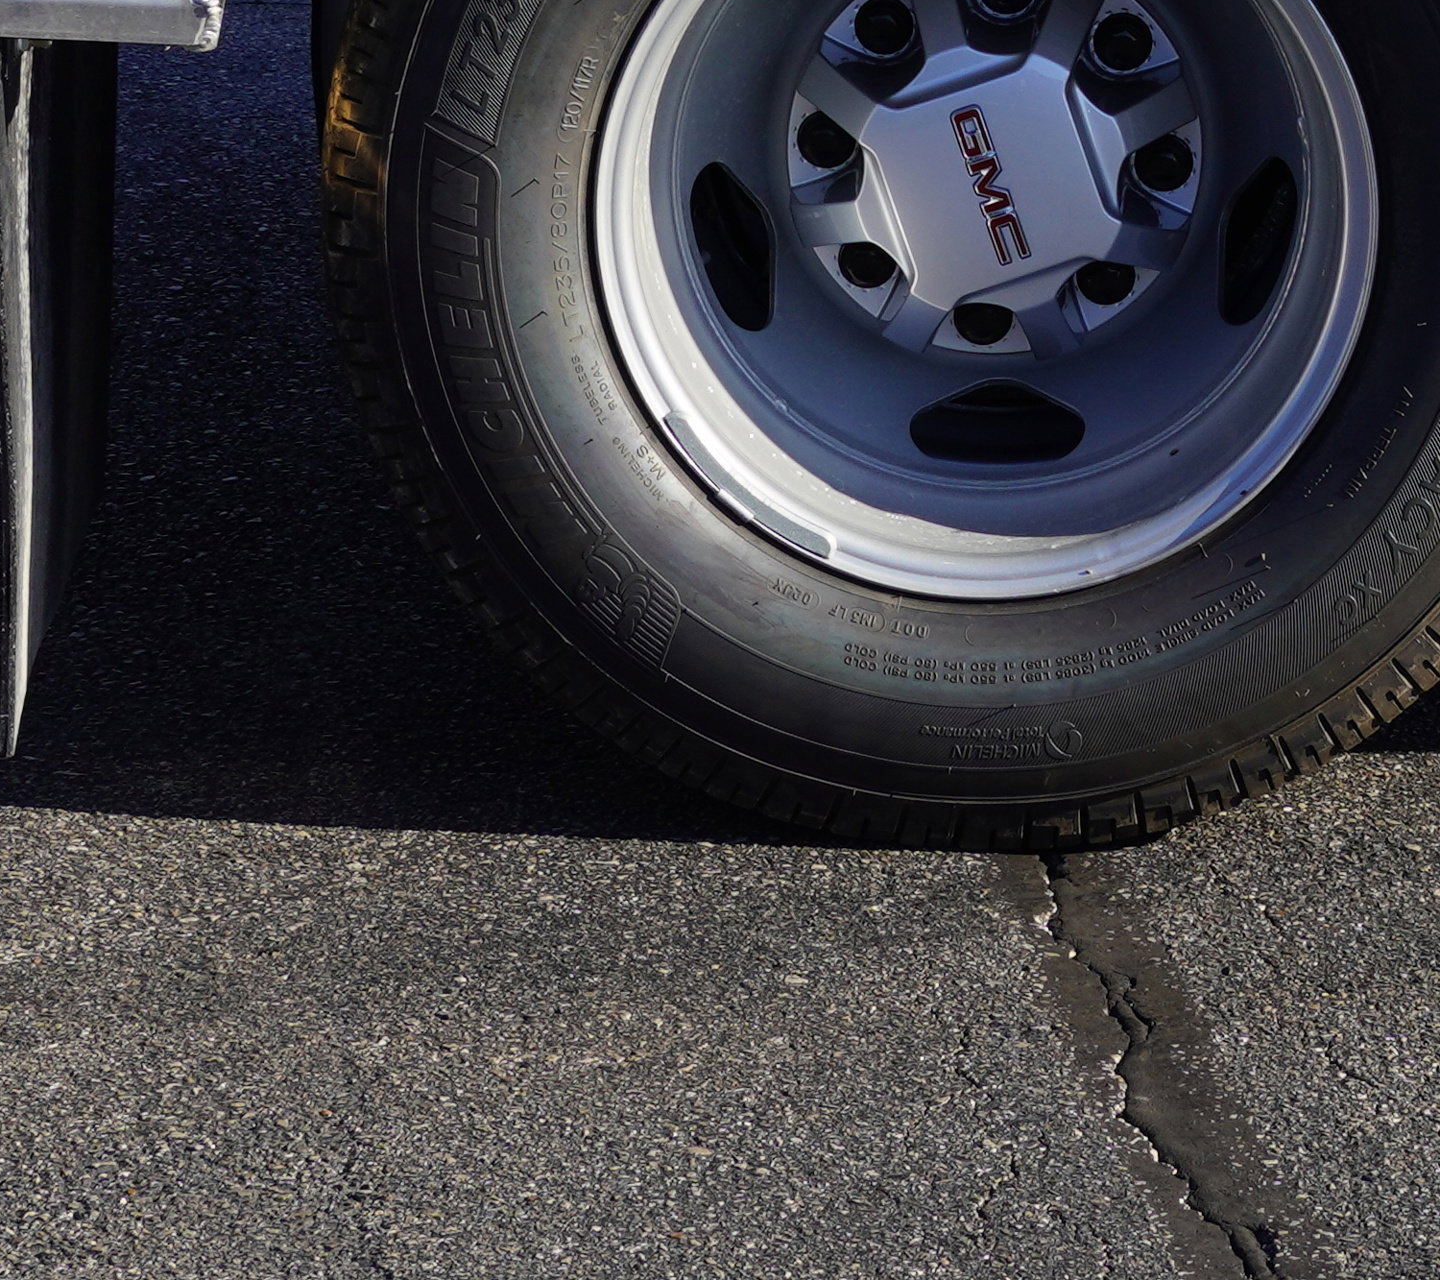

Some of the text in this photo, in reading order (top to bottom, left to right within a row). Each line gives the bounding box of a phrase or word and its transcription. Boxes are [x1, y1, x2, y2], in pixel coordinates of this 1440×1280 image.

[950, 104, 1032, 266] GMC
[432, 162, 590, 548] MICHELIN
[569, 353, 610, 427] TUBELESS
[587, 359, 619, 413] RADIAL
[632, 441, 668, 483] M+S
[1191, 598, 1227, 625] LOAD
[1336, 575, 1386, 625] XC
[890, 618, 928, 640] DOT
[1199, 607, 1235, 634] LOAD
[842, 639, 878, 659] COLD
[842, 653, 878, 673] COLD
[950, 740, 1043, 761] MICHELIN
